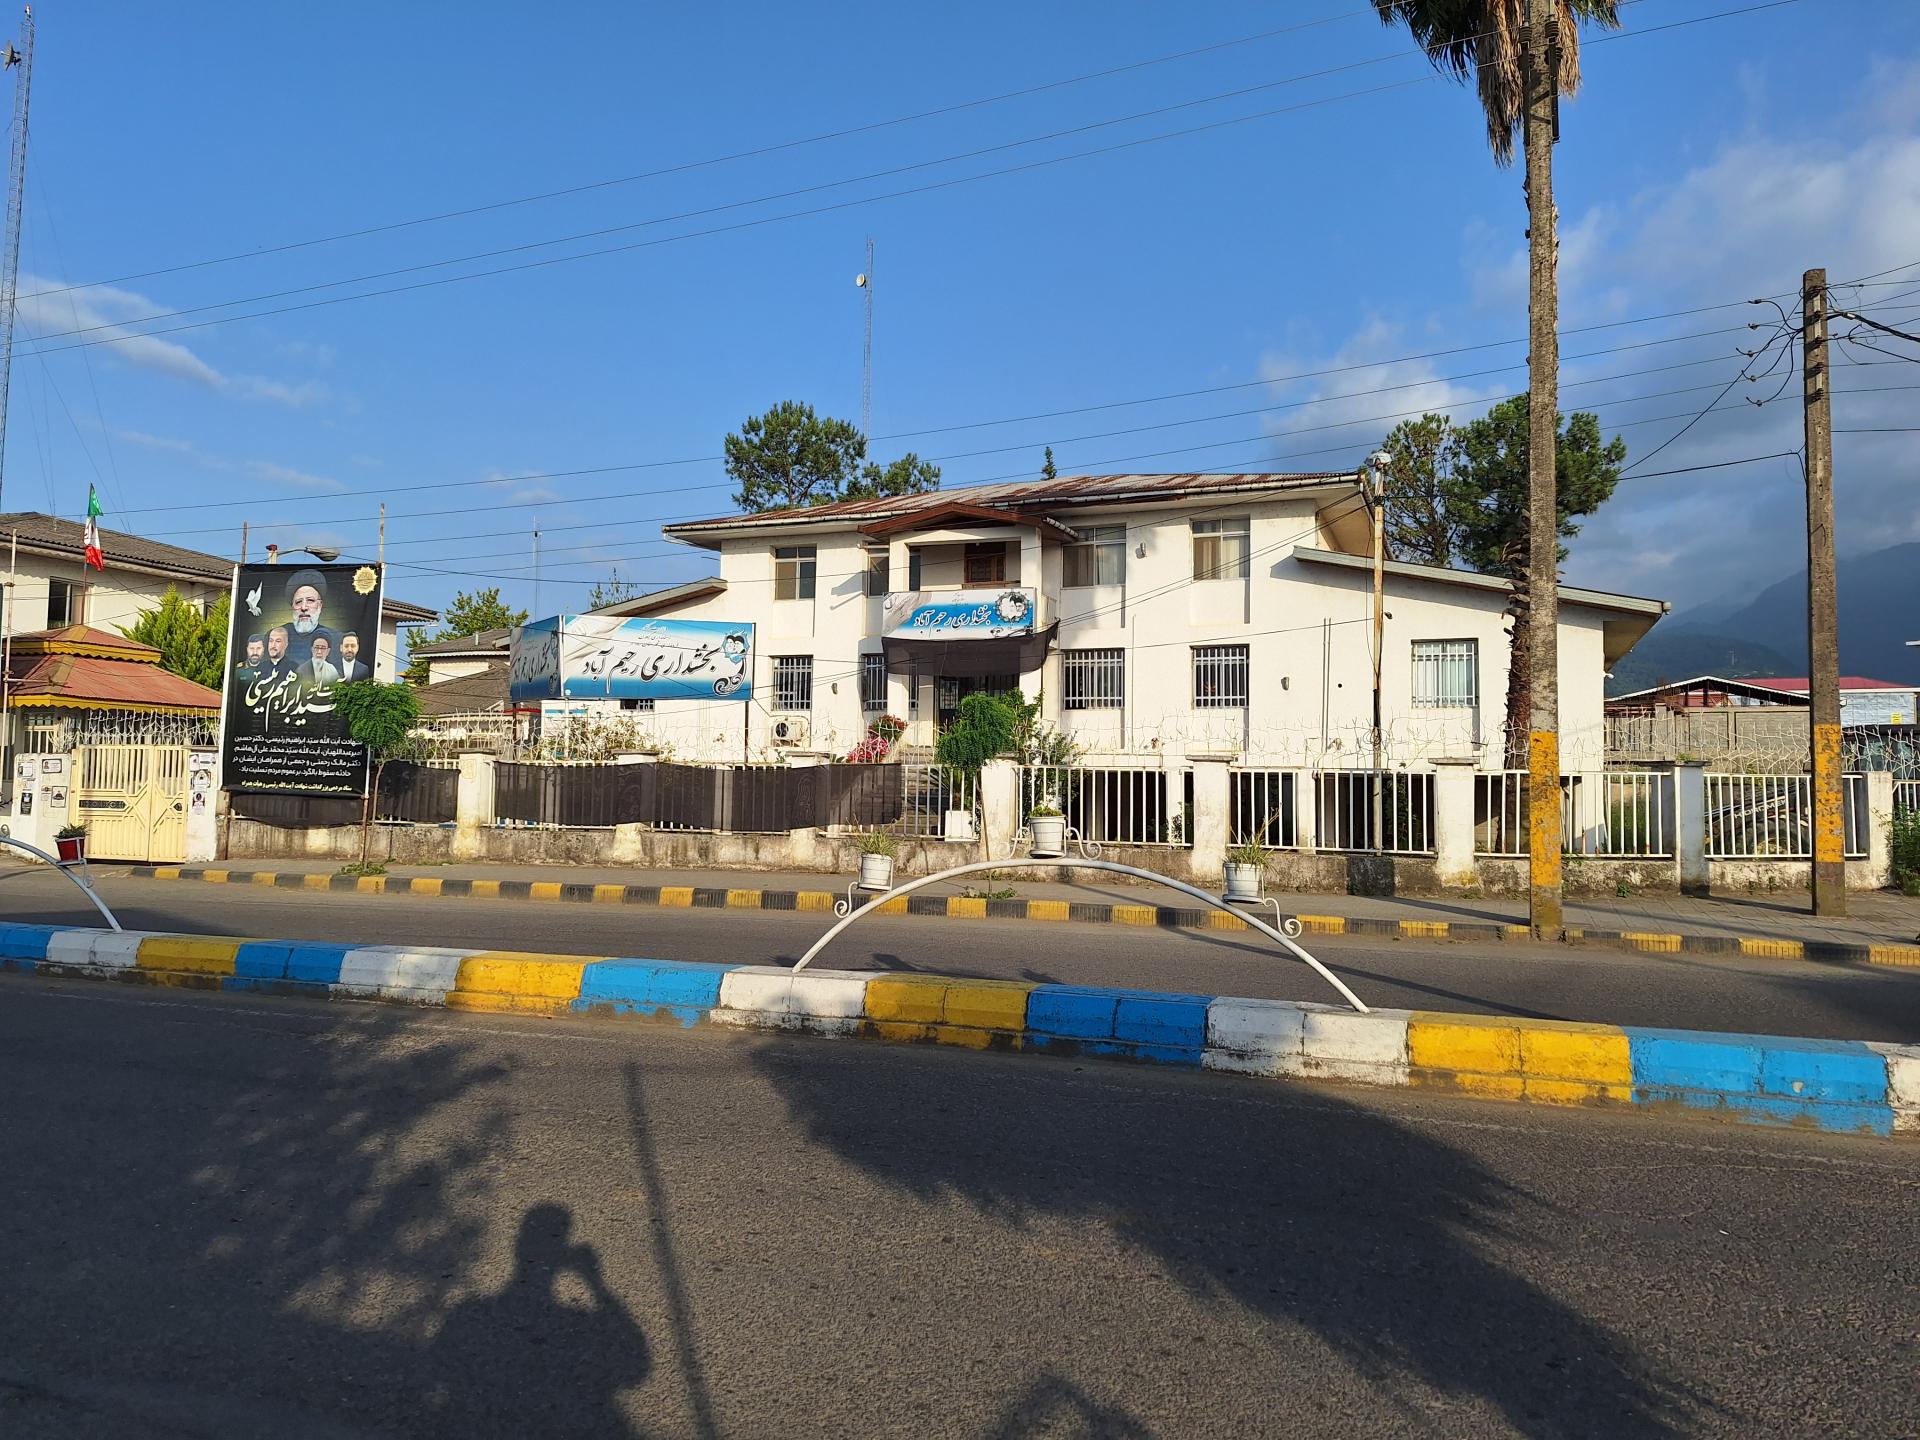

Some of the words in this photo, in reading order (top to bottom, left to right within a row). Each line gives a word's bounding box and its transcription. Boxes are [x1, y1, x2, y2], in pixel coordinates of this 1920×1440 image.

[913, 609, 936, 634] آباد
[951, 604, 992, 630] بخشداری
[582, 644, 615, 681] آباد
[640, 643, 721, 682] بخشداری
[606, 650, 639, 695] رحیم
[264, 669, 302, 733] ابراهیم
[252, 735, 265, 743] دکتر
[285, 736, 306, 745] ابراهیم
[319, 734, 330, 744] الله
[330, 737, 341, 746] آیت
[257, 746, 269, 754] علی
[308, 747, 321, 756] آیت
[239, 755, 257, 764] ایشان
[257, 756, 282, 765] همراهان
[310, 759, 330, 767] رحمتی
[346, 760, 362, 768] دکتر
[249, 766, 267, 774] تسلیت
[267, 768, 281, 776] مردم
[318, 769, 336, 777] سقوط
[335, 769, 352, 777] حادثه
